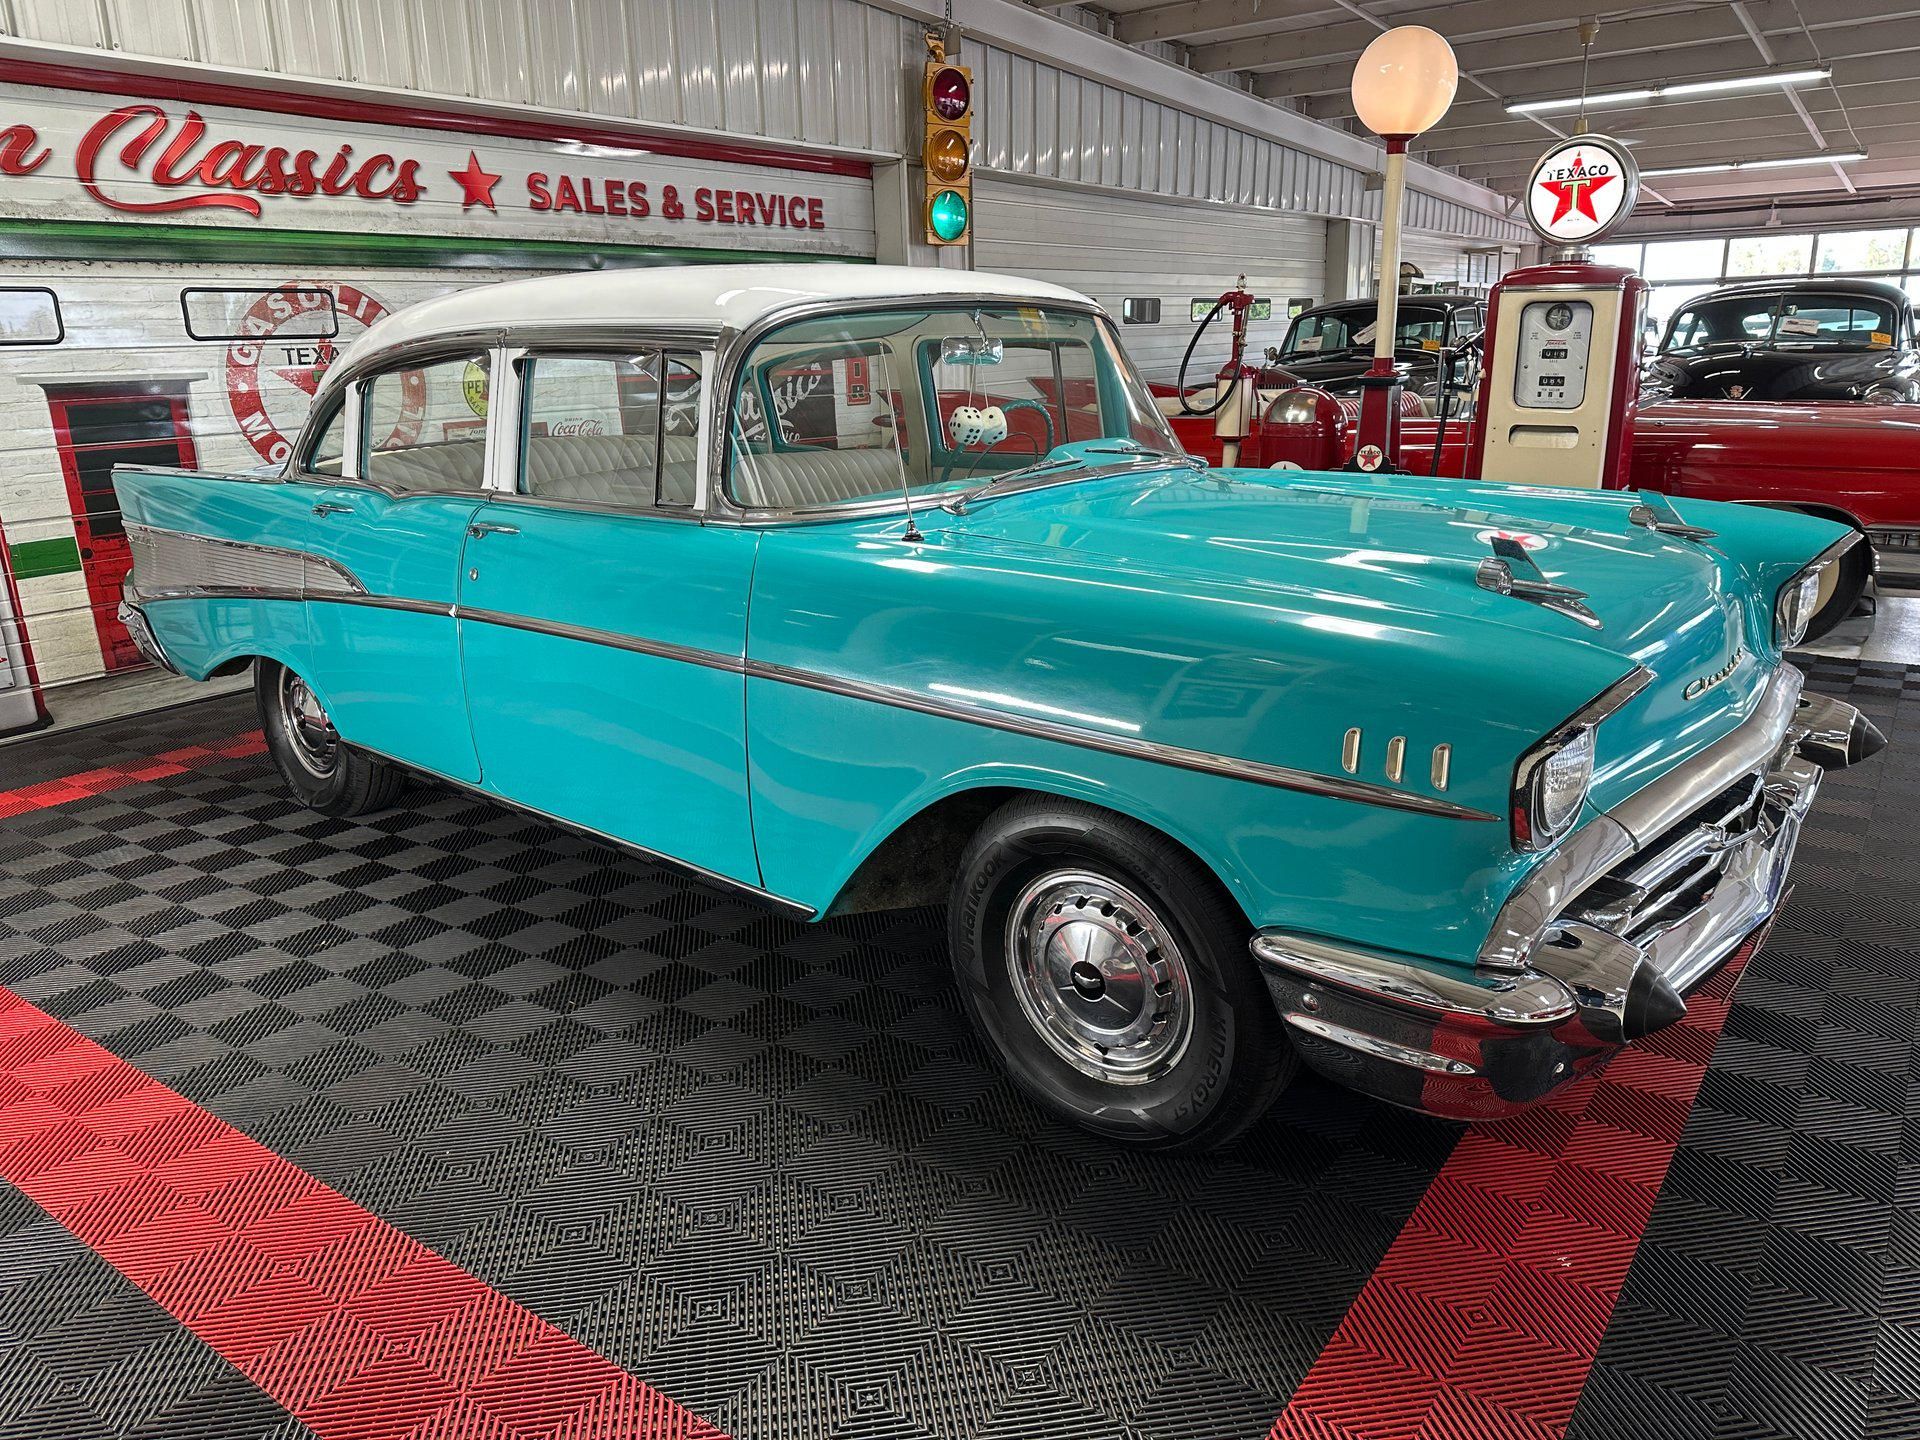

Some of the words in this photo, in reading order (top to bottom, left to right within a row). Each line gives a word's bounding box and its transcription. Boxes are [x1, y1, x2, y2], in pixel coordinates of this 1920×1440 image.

[76, 104, 427, 218] Classics
[527, 170, 651, 218] SALES
[661, 184, 686, 220] &
[694, 186, 825, 230] SERVICE
[1546, 164, 1609, 181] TEXACO
[1190, 1010, 1226, 1114] KINERGY
